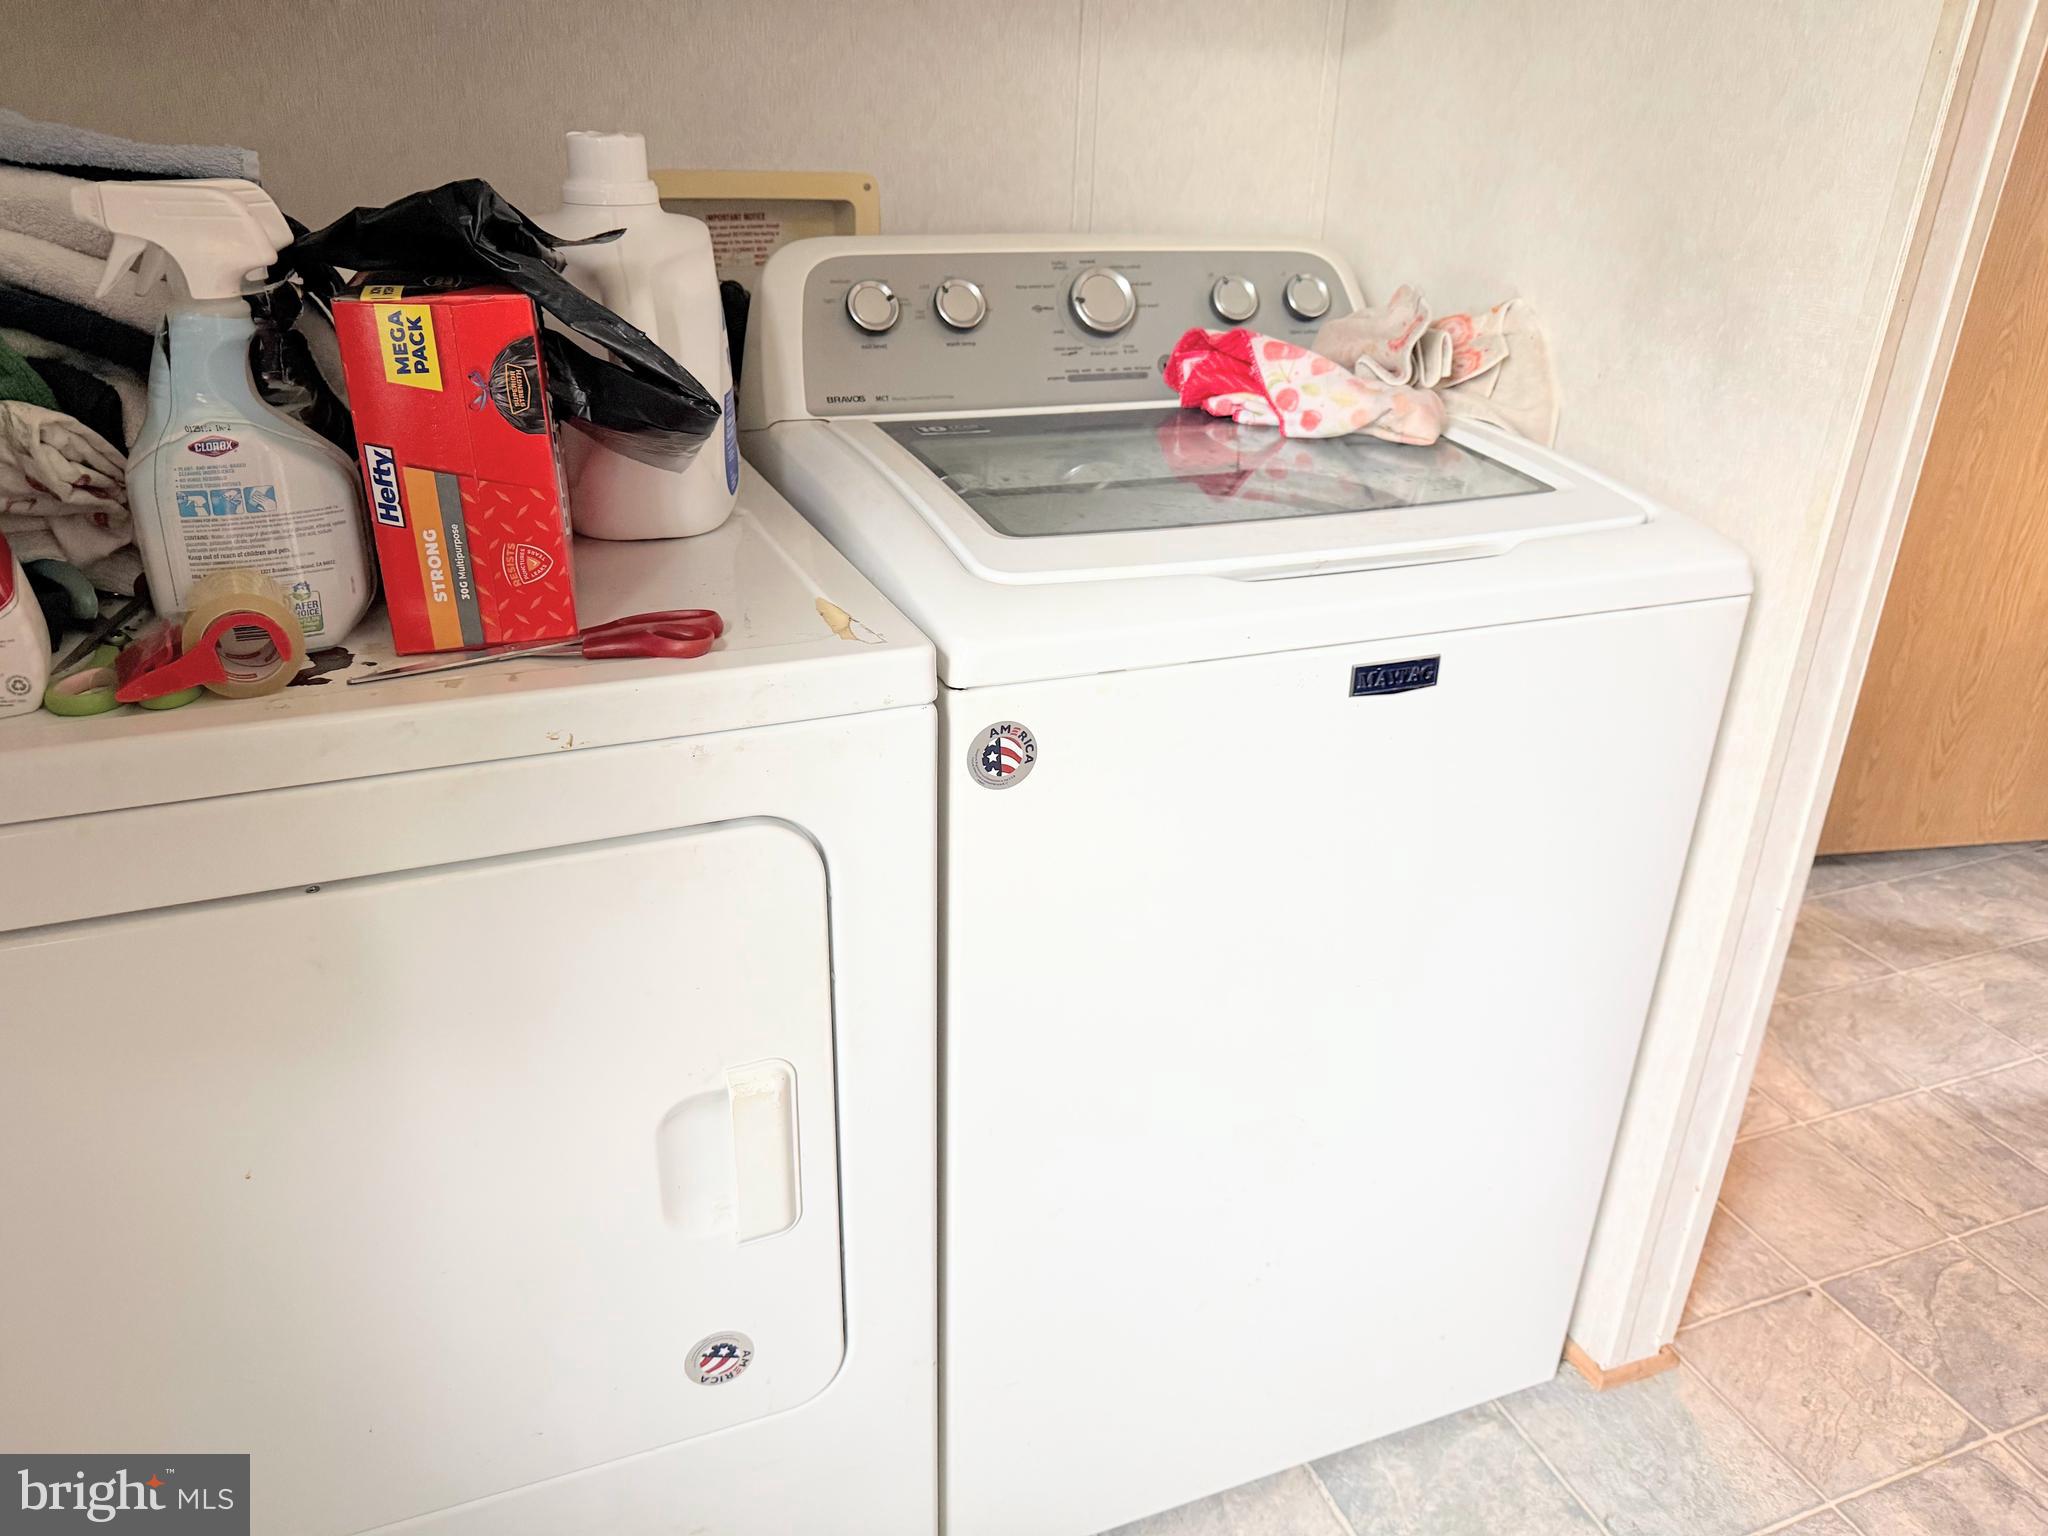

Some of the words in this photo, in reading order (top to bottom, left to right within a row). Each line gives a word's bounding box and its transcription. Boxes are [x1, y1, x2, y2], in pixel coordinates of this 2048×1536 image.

[744, 212, 765, 220] NOTICE
[387, 310, 411, 375] MEGA
[406, 315, 430, 374] PACK
[510, 370, 520, 407] SUPERIOR
[515, 369, 527, 408] STRENGTH
[826, 394, 866, 404] BRAVOS
[194, 440, 233, 452] CLOROX
[373, 449, 400, 522] Hefty
[423, 529, 448, 603] STRONG
[452, 524, 469, 580] Multipurpose
[505, 542, 521, 587] RESISTS
[295, 600, 319, 611] AFER
[459, 581, 470, 601] 30G
[297, 607, 320, 617] OICE
[1357, 664, 1434, 689] MAYTAG
[989, 724, 1035, 765] AMERICA
[700, 1350, 751, 1384] AMERICA
